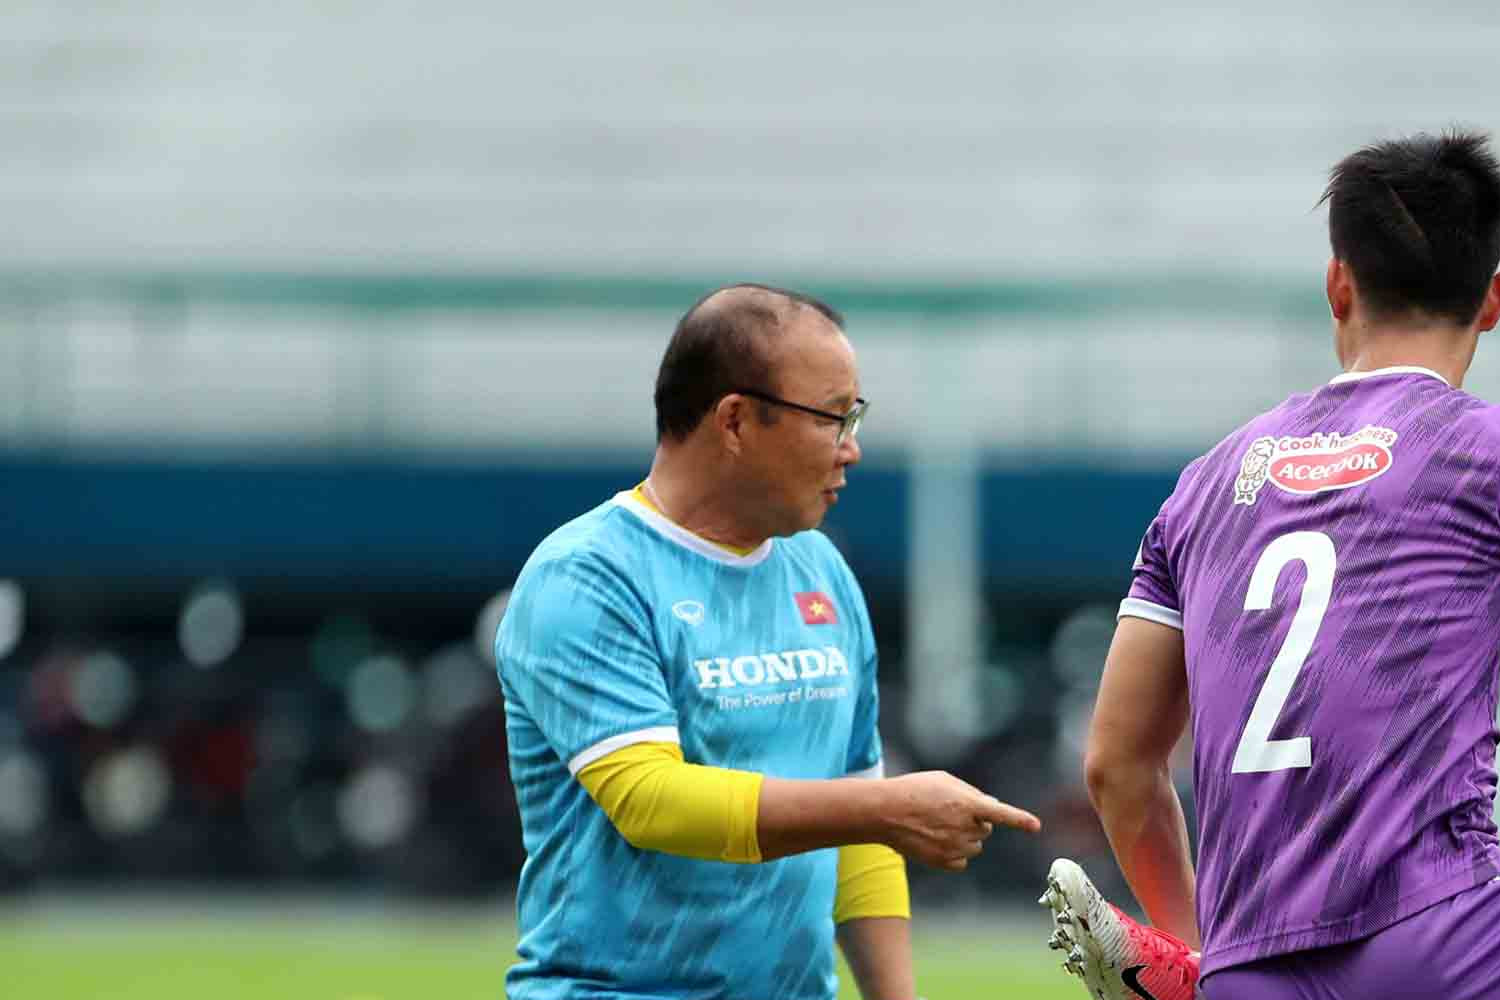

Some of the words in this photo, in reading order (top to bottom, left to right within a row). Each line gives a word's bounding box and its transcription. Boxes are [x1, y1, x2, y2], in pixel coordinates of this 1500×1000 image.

[1278, 435, 1323, 451] Cook
[694, 647, 849, 689] HONDA
[1231, 531, 1337, 774] 2
